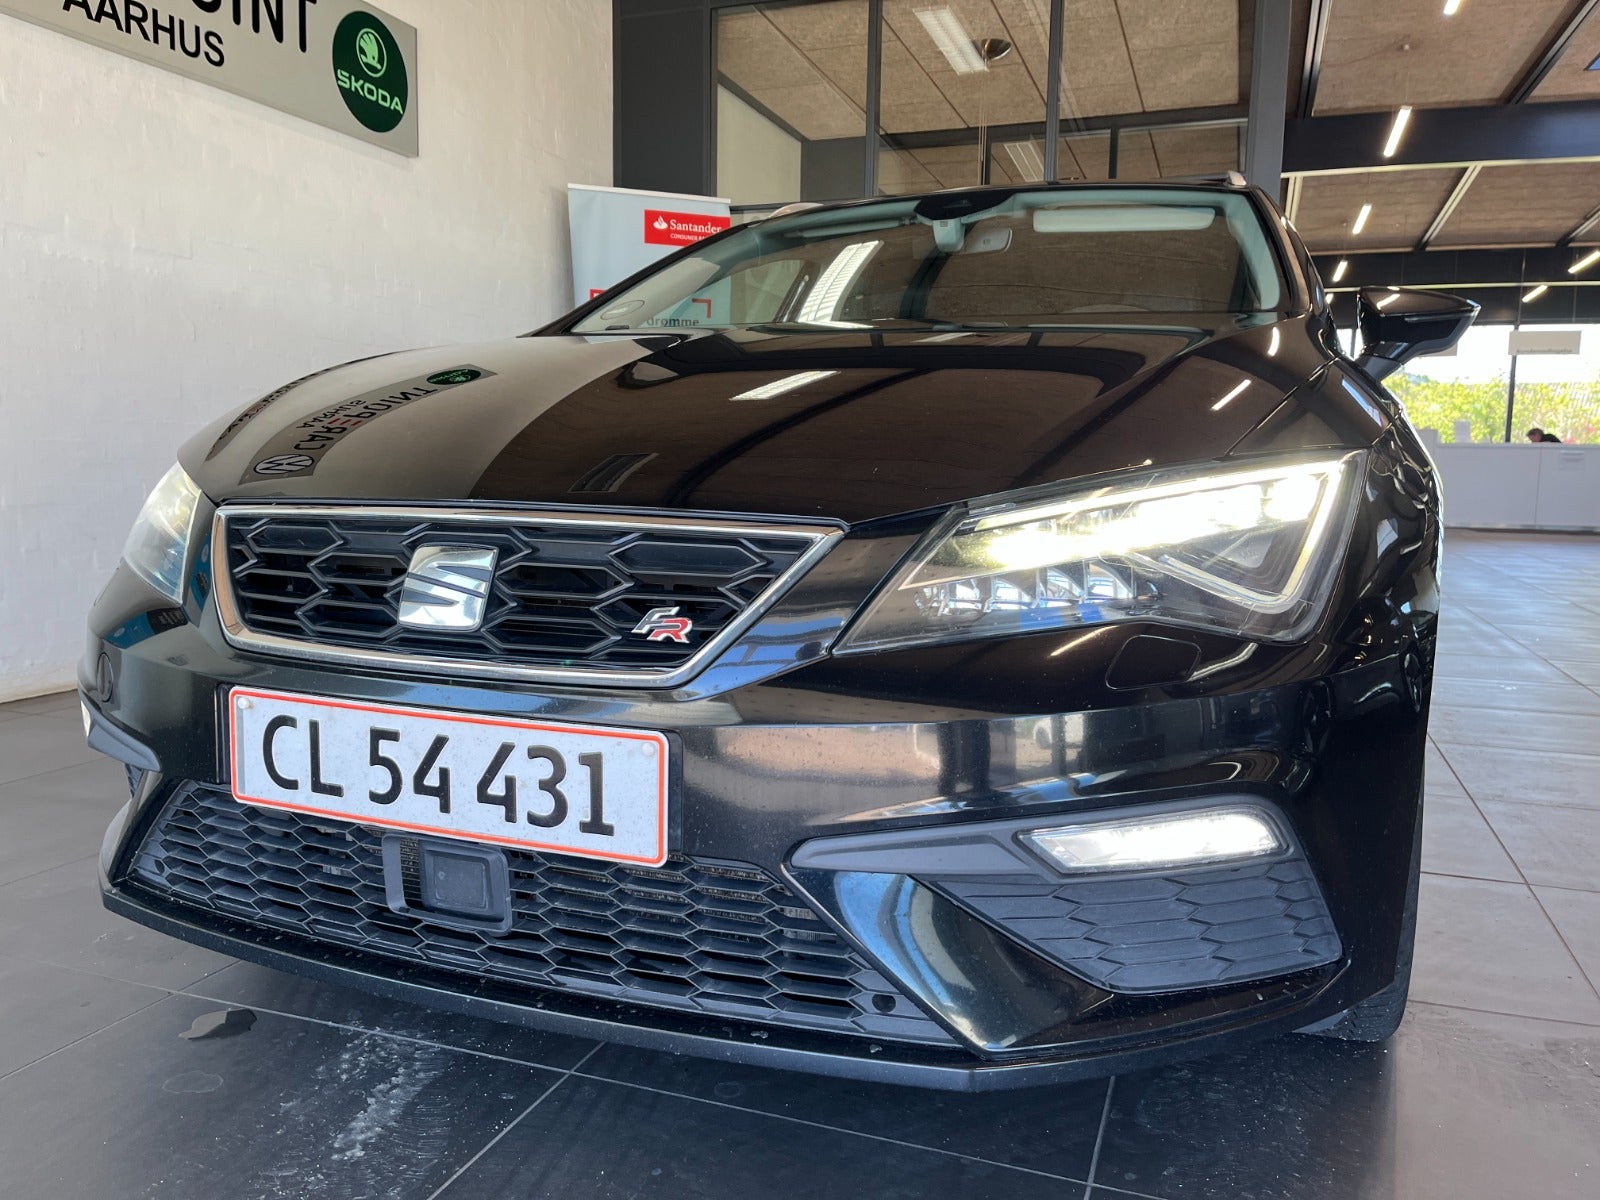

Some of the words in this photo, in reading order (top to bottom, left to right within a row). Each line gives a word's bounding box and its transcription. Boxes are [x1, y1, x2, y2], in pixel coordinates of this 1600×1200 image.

[337, 68, 404, 115] SKODA
[669, 219, 722, 234] Santander
[631, 606, 693, 644] FR
[262, 714, 345, 797] CL
[368, 725, 451, 814] 54
[476, 741, 615, 836] 431
